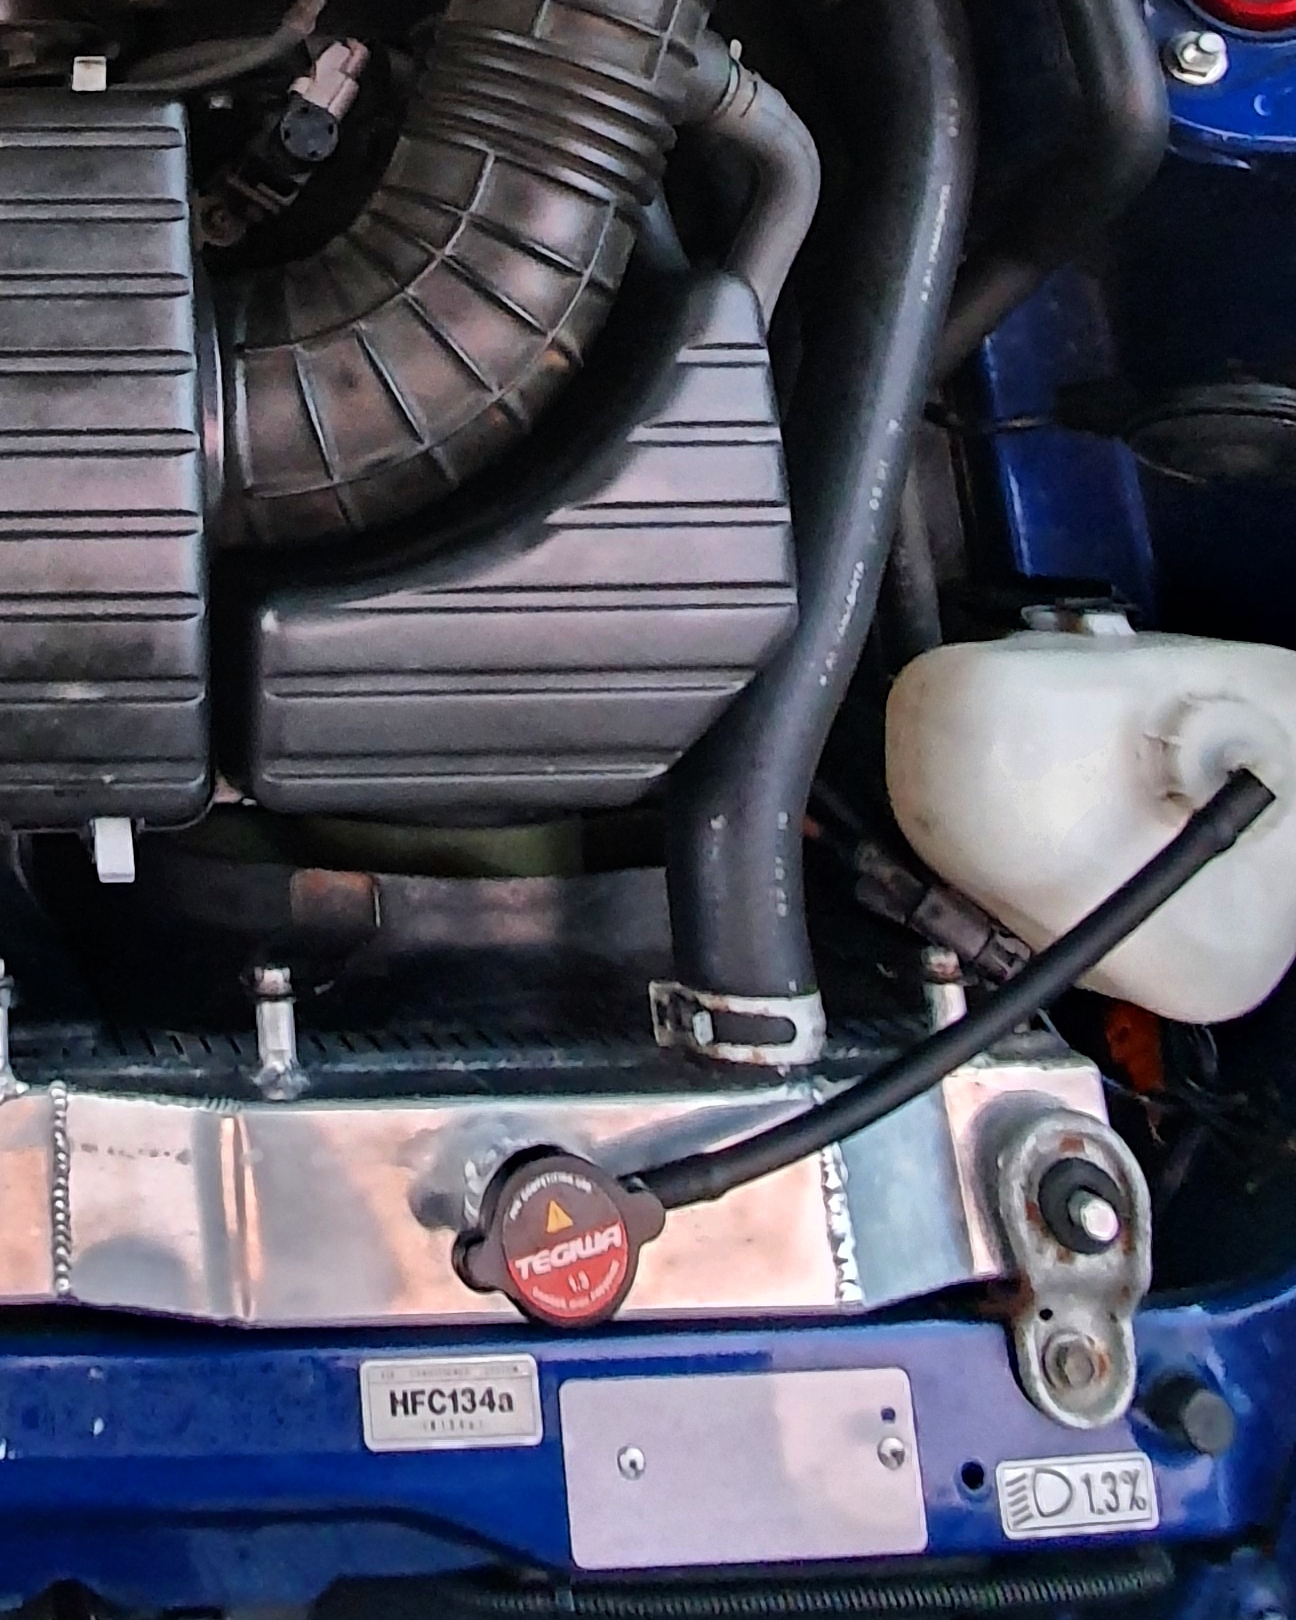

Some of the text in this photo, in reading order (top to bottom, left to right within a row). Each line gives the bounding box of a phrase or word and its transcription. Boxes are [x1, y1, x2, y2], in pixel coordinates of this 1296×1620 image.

[515, 1223, 622, 1281] TEGIWA
[389, 1387, 514, 1417] HFC134a
[1081, 1469, 1147, 1515] 1.3%
